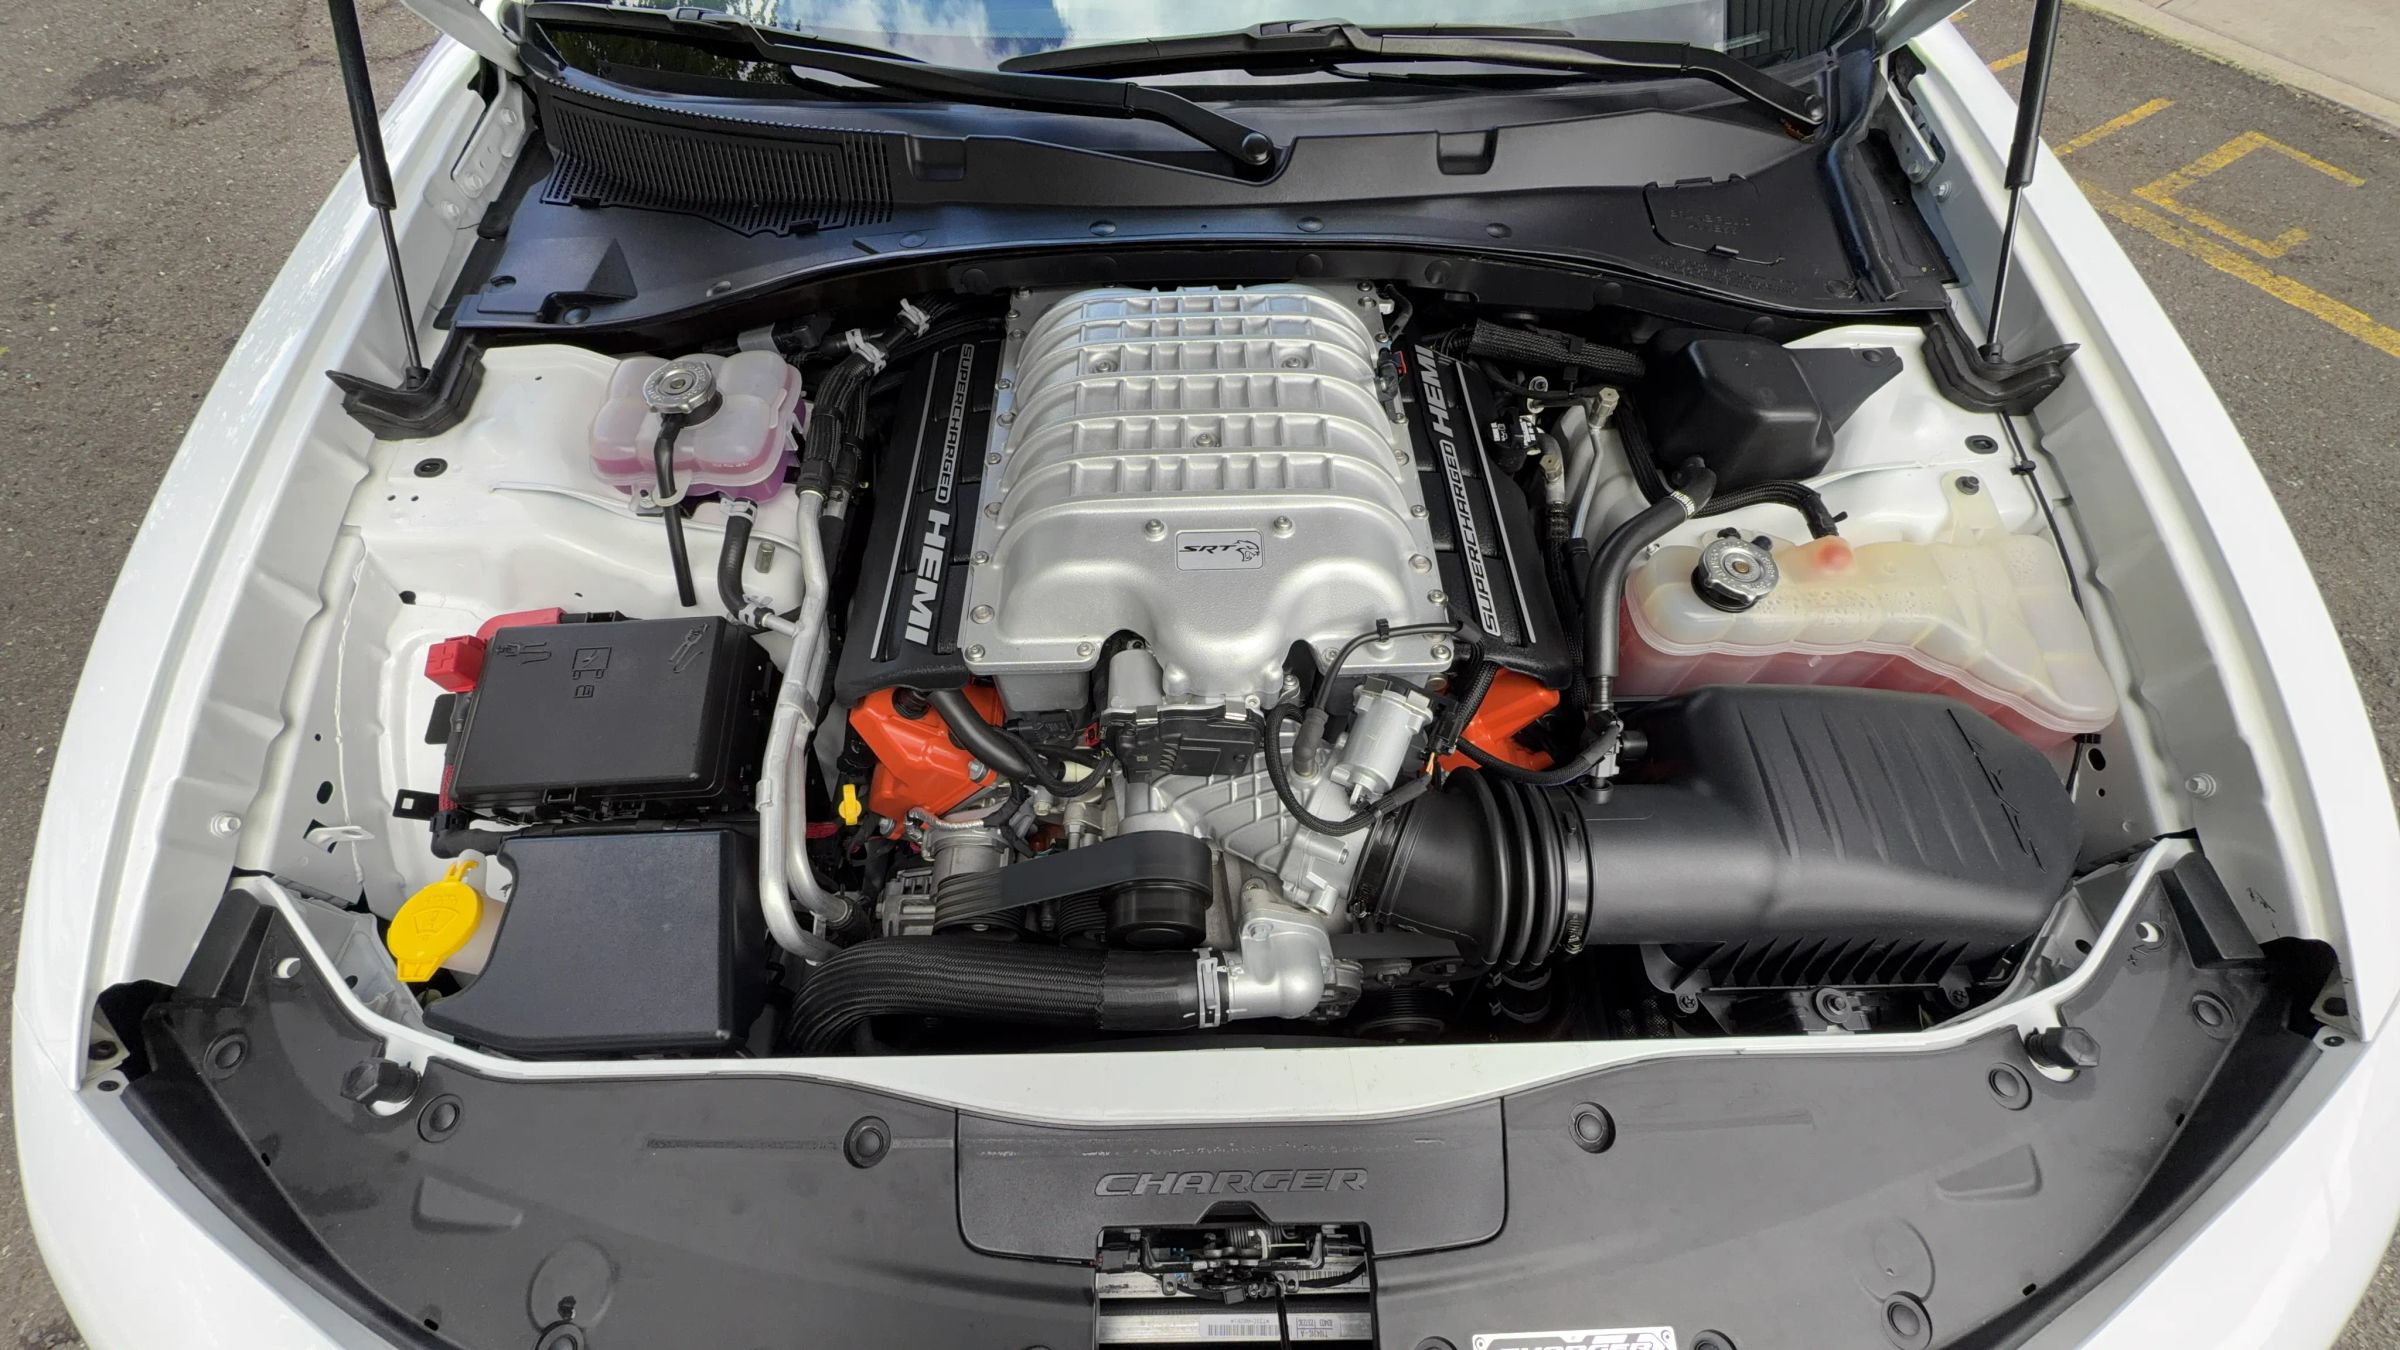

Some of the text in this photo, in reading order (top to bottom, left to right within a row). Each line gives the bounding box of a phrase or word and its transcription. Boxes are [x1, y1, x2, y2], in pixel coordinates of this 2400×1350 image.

[905, 344, 974, 645] SUPERCHARGED HEMI
[1179, 545, 1237, 554] SRT
[1414, 345, 1500, 636] SUPERCHARGED HEMI
[1095, 1168, 1368, 1196] CHARGER
